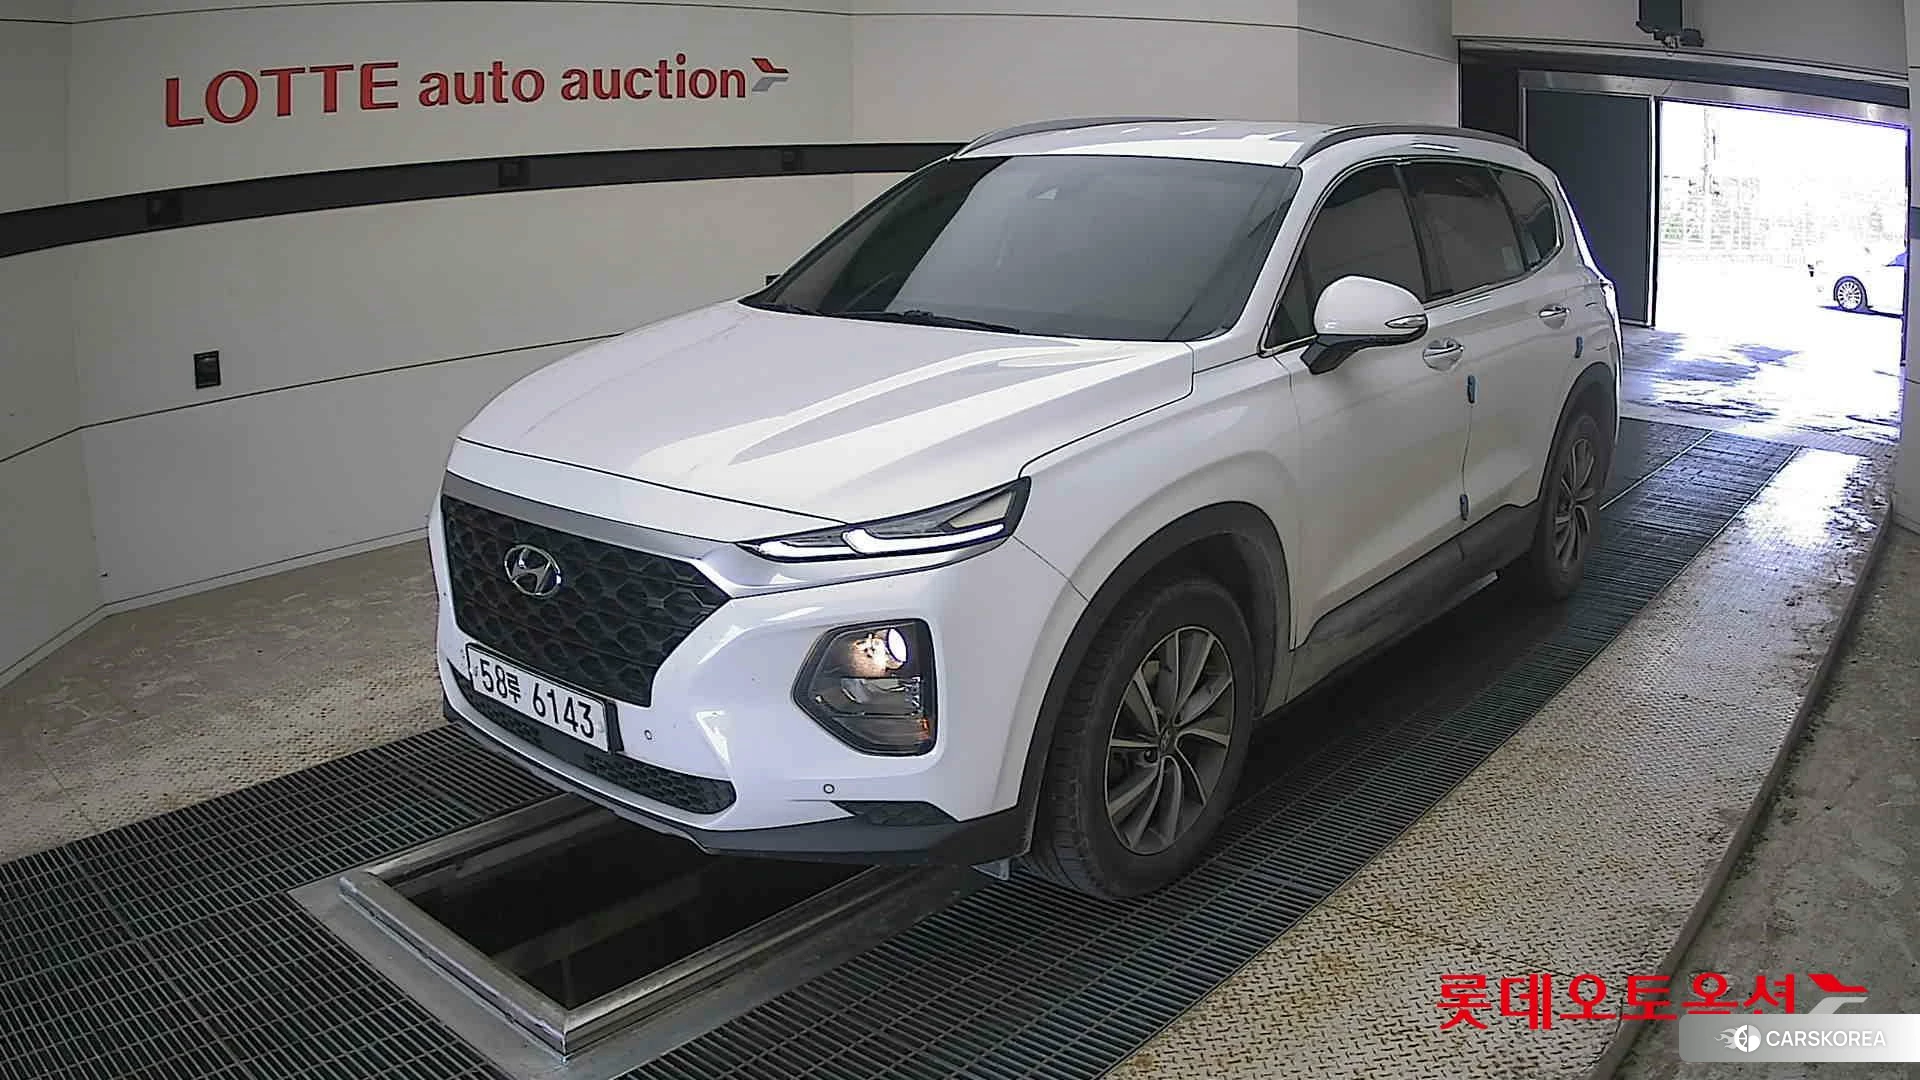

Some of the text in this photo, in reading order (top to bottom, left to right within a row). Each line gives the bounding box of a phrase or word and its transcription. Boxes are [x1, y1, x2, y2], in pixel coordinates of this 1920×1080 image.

[165, 53, 747, 128] LOTTE auto auction
[479, 657, 595, 739] 58루 6143
